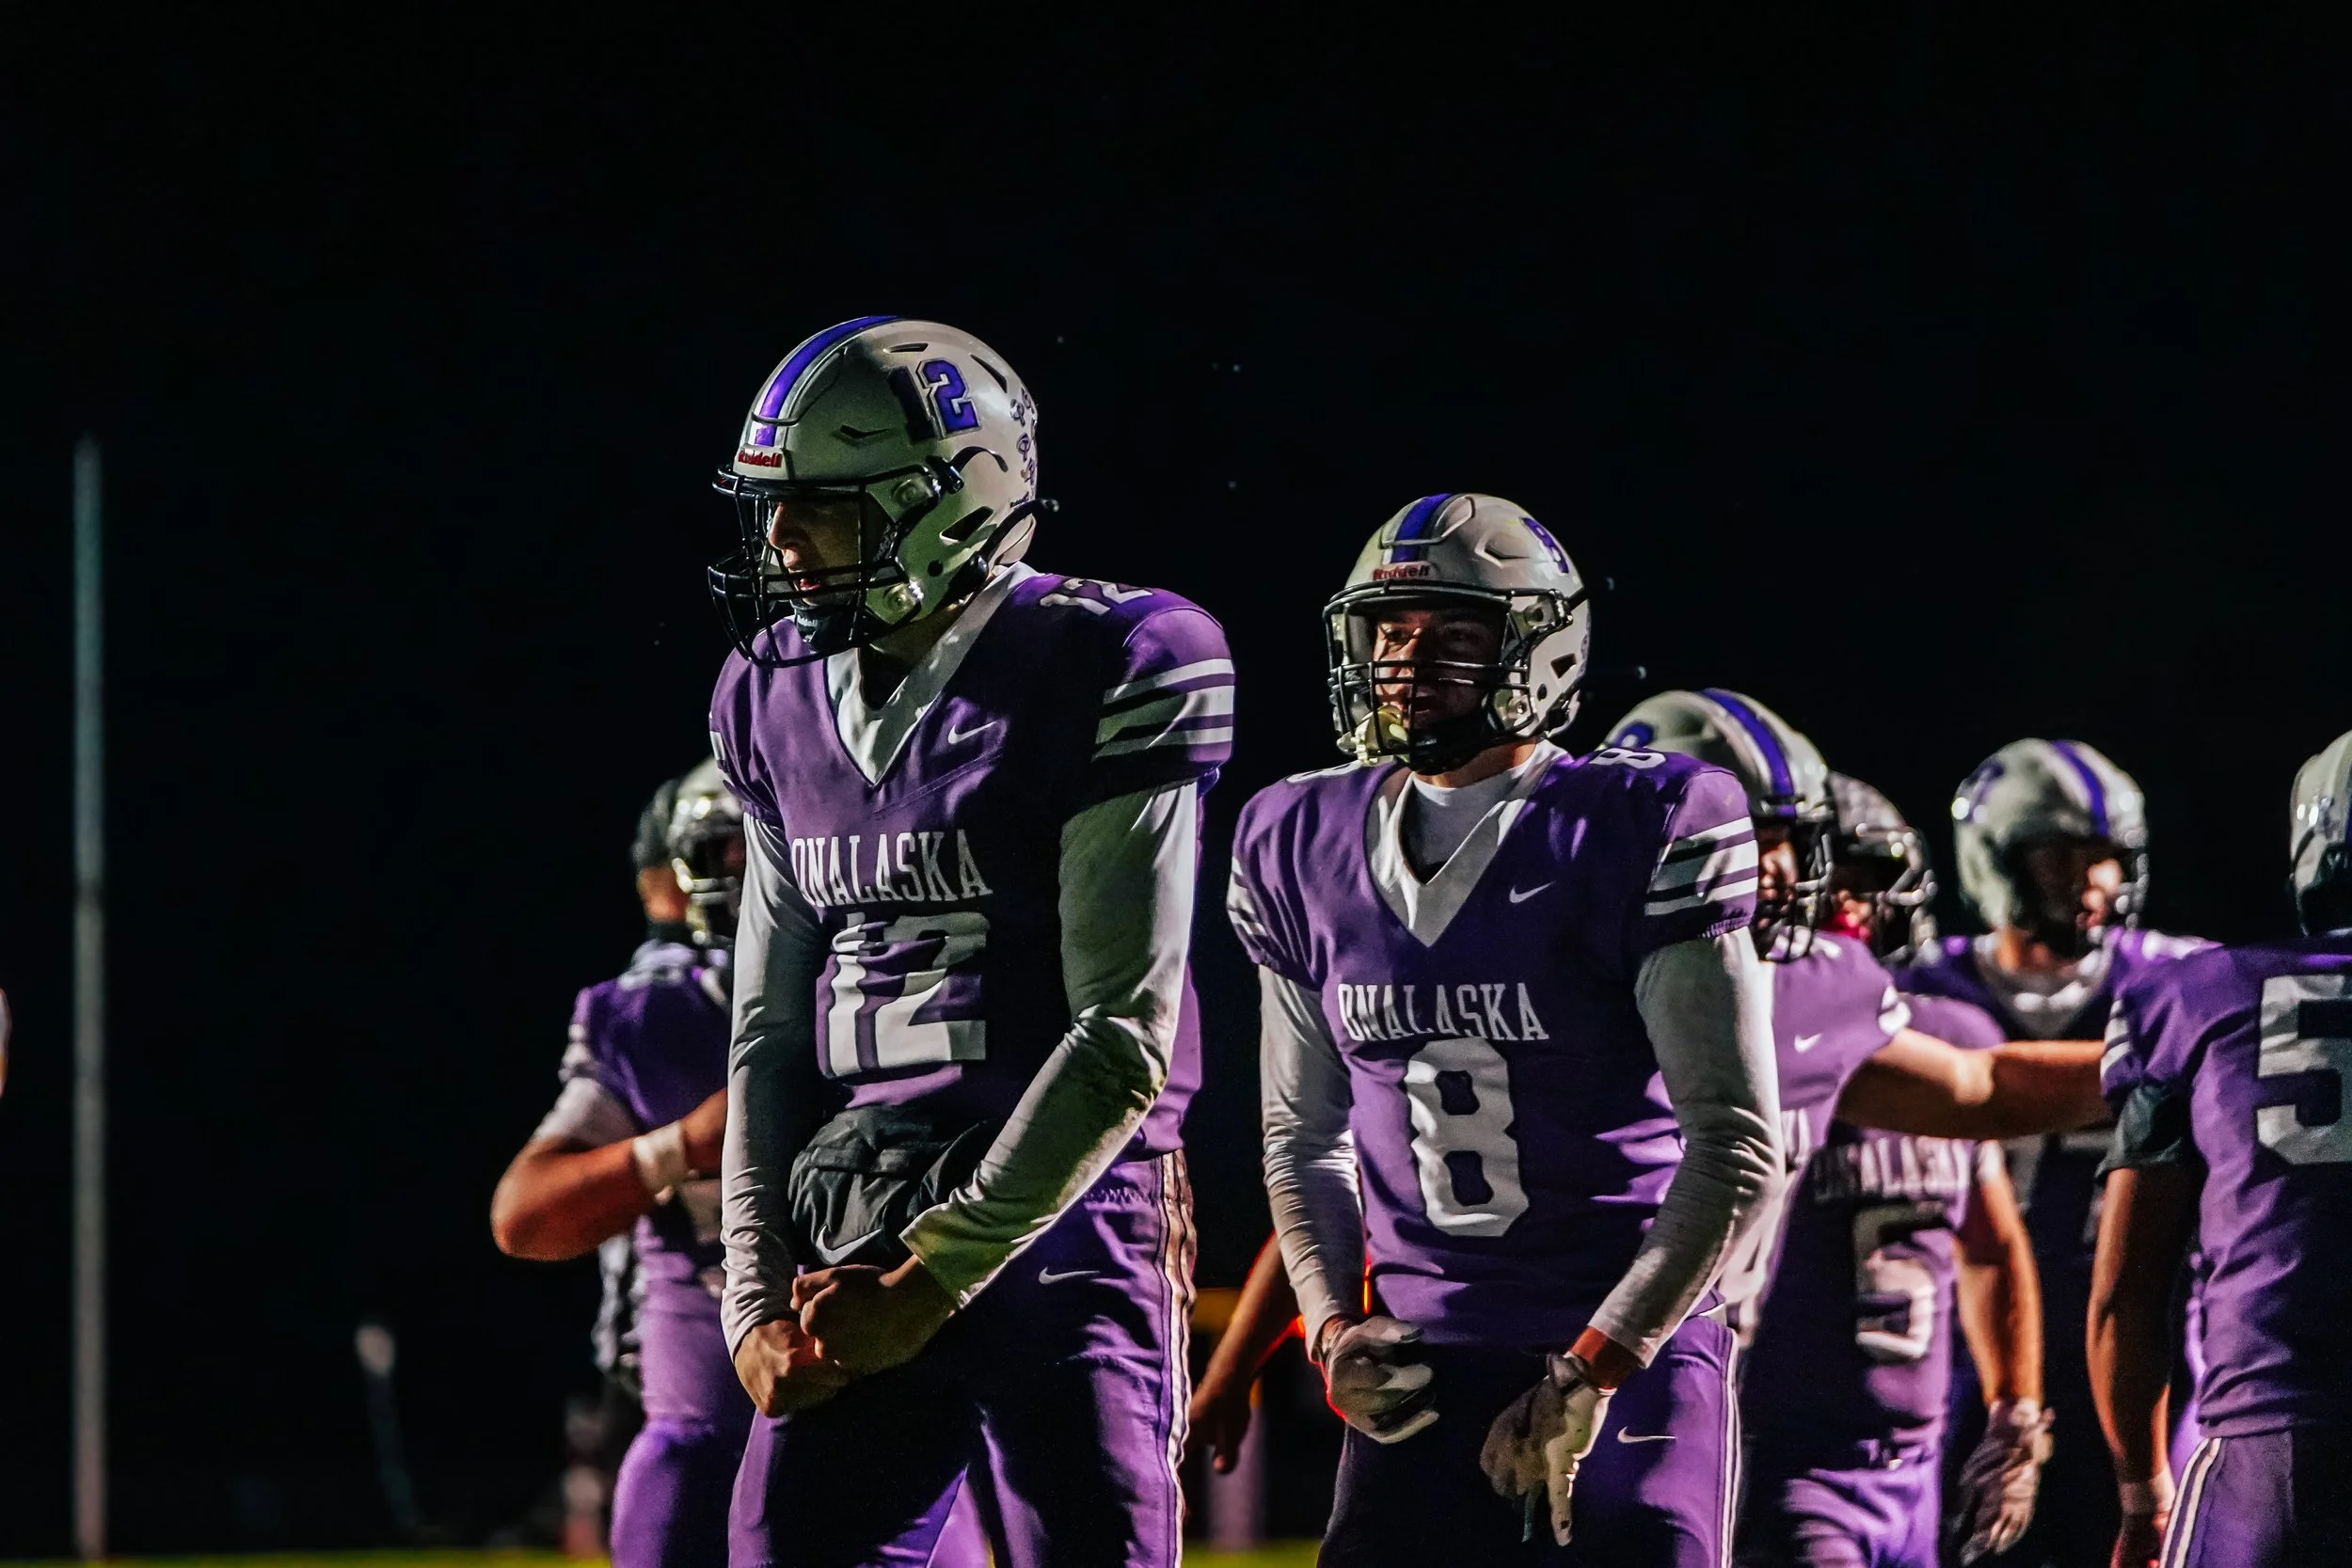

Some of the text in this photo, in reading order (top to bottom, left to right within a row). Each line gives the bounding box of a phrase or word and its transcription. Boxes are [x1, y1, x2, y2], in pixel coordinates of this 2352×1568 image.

[790, 829, 993, 908] ONALASKA
[828, 911, 991, 1077] 12
[1337, 982, 1550, 1041] ONALASKA
[2257, 974, 2352, 1165] 5
[1403, 1036, 1530, 1238] 8
[1851, 1199, 1935, 1364] 5
